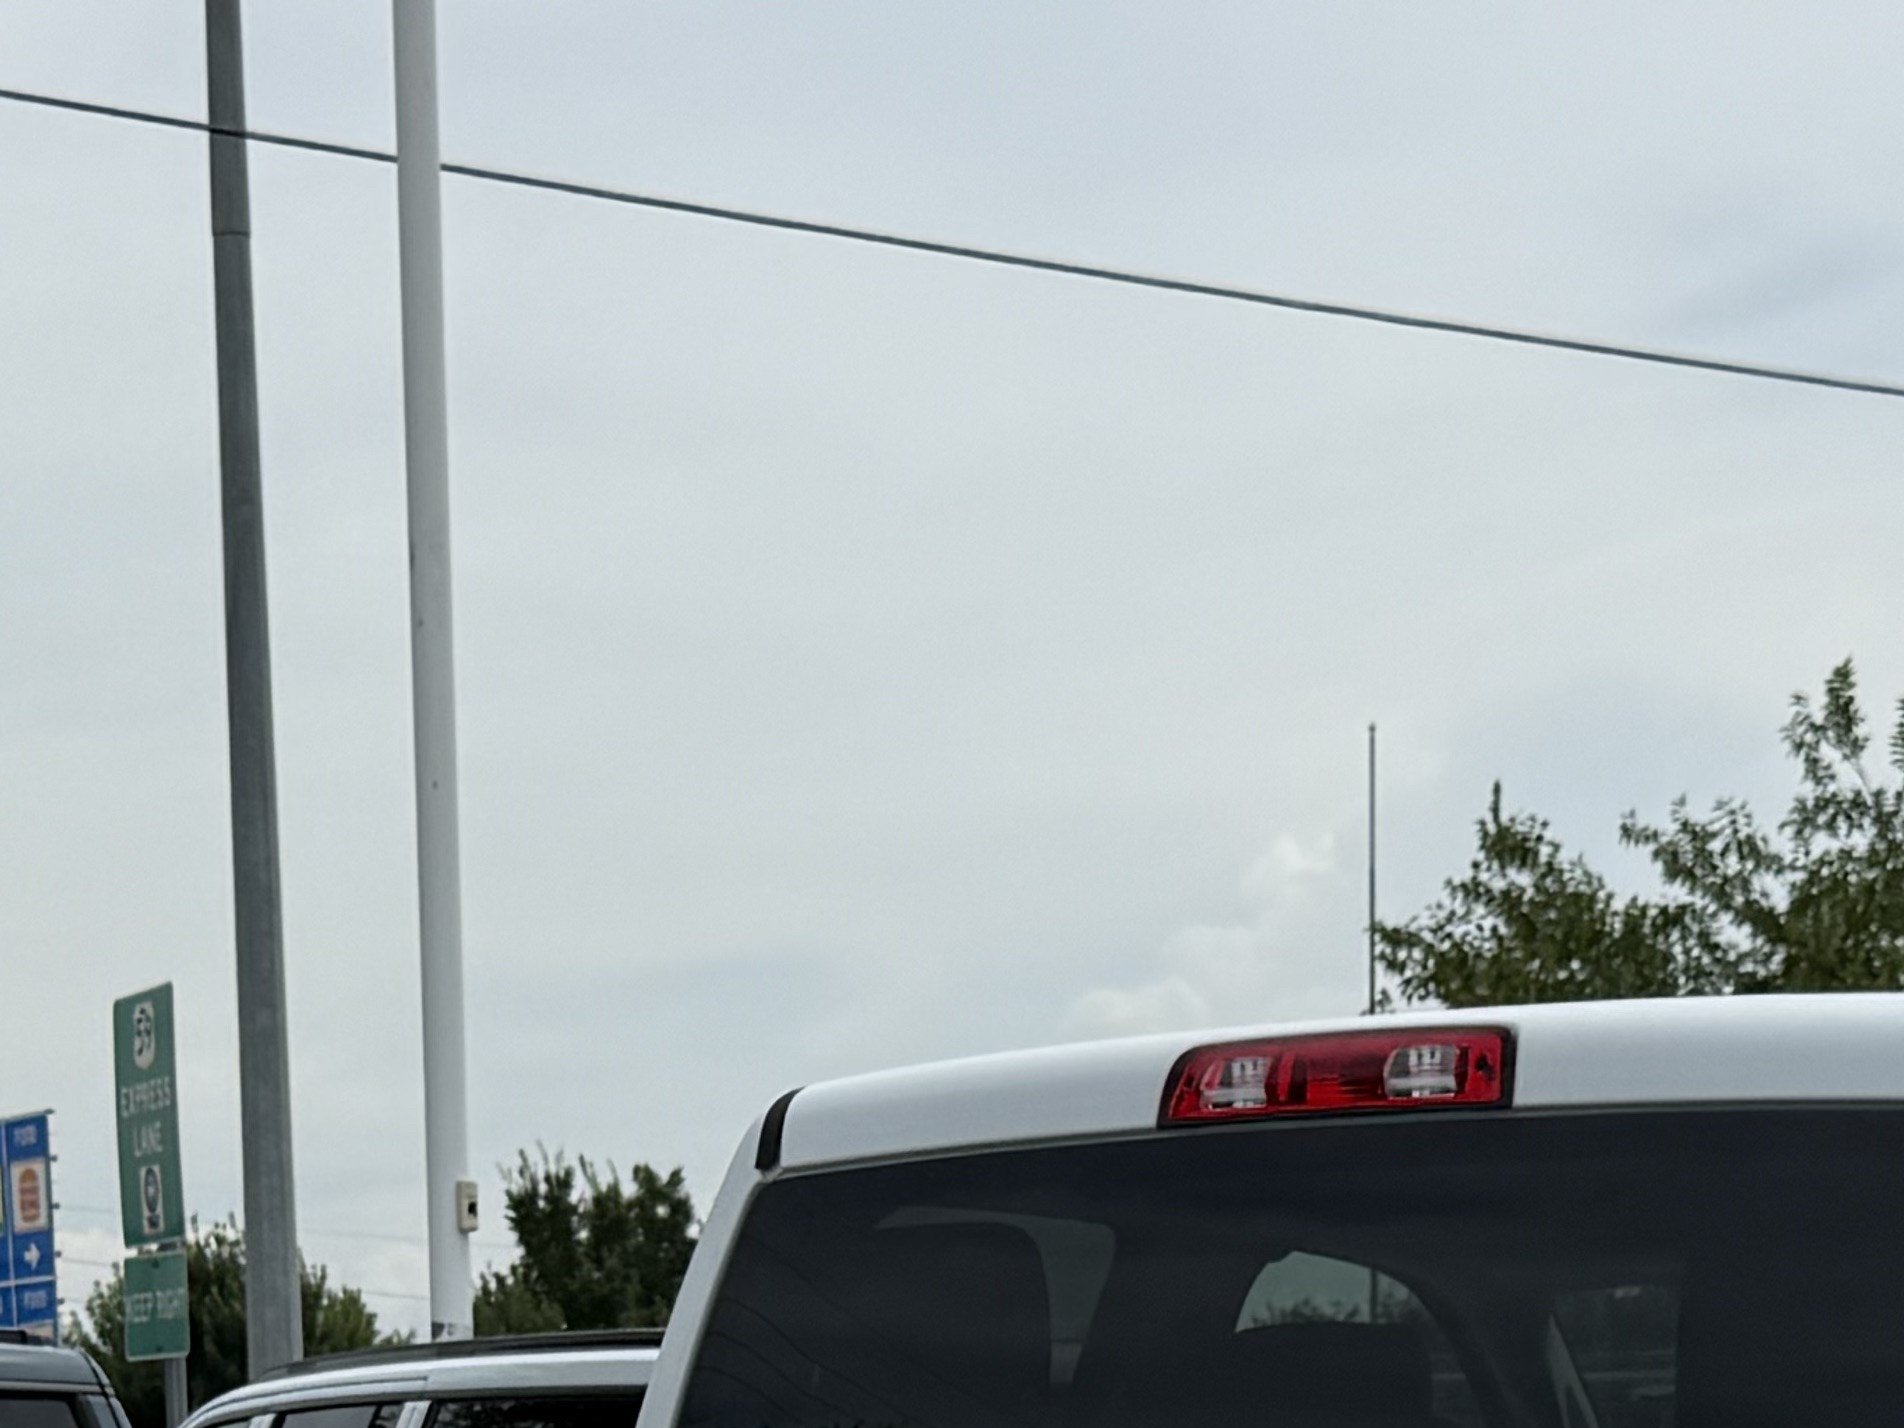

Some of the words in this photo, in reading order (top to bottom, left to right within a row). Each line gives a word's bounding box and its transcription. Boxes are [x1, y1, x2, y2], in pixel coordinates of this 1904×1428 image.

[120, 1076, 171, 1118] EXPRESS
[133, 1121, 163, 1158] LANE
[124, 1290, 152, 1322] KEEP
